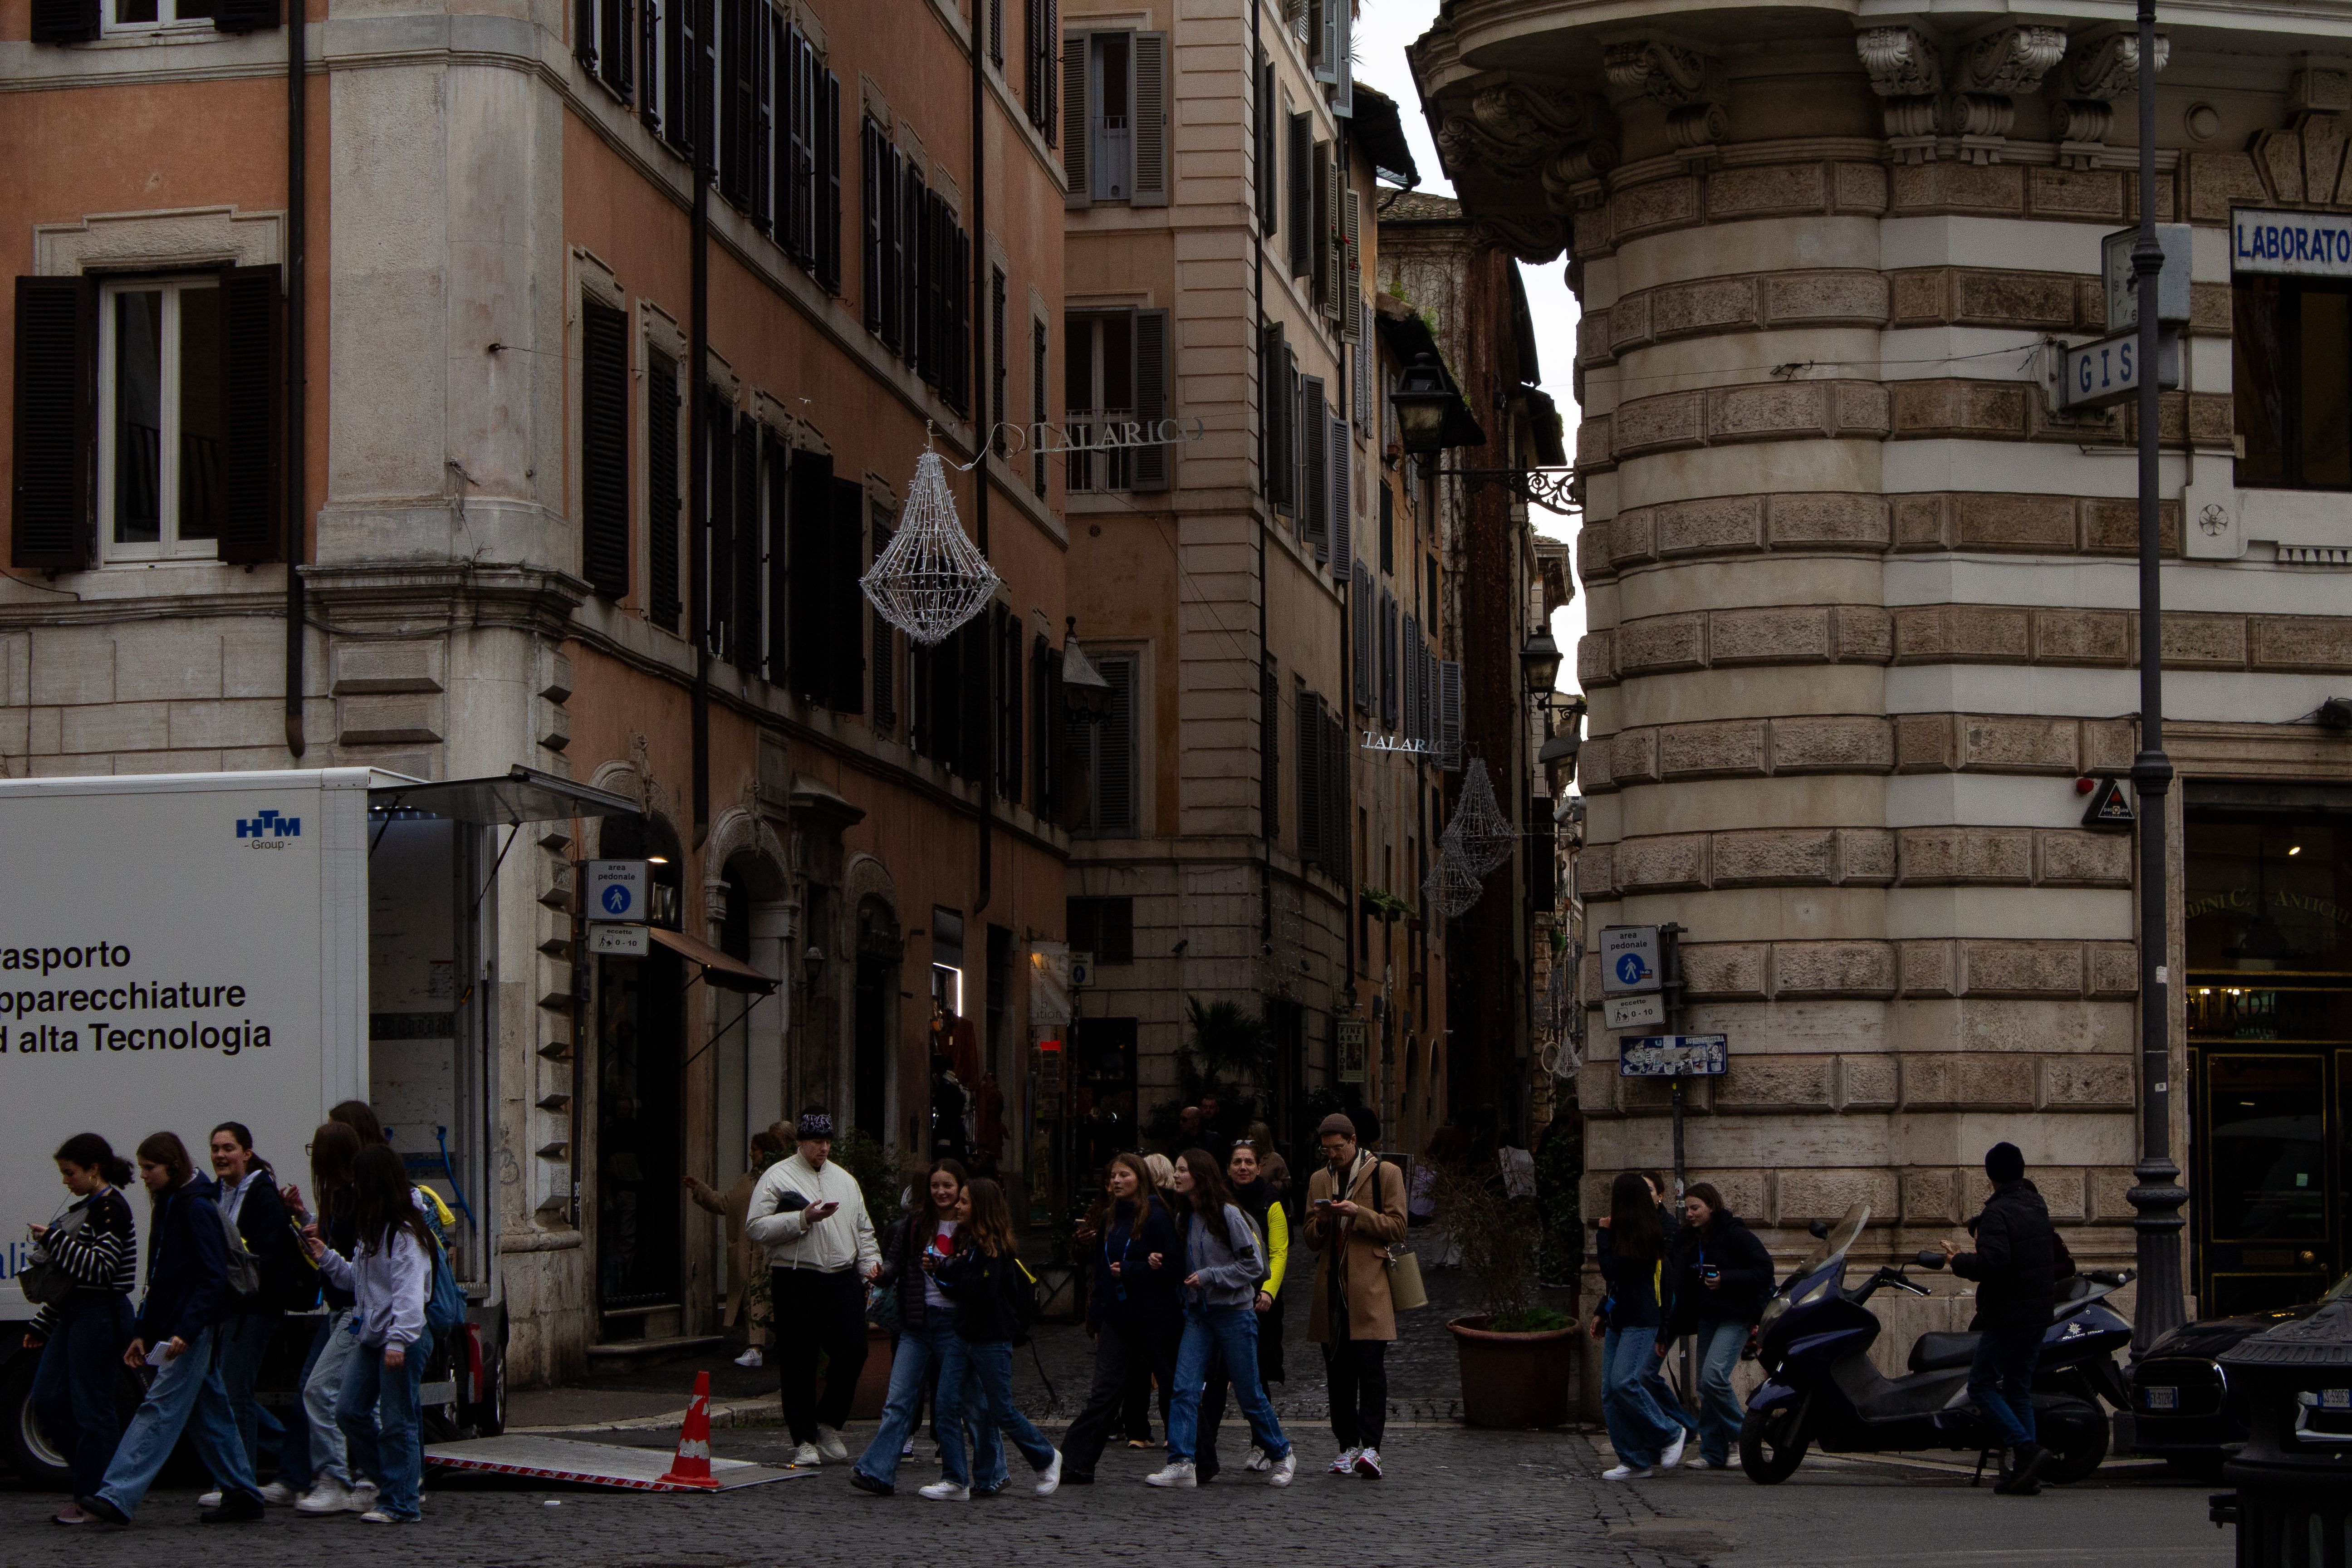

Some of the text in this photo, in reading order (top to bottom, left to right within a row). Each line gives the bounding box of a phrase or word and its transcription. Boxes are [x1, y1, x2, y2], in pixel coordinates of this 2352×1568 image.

[2237, 225, 2352, 262] LABORATO
[1362, 730, 1447, 753] TALARIC
[236, 810, 300, 838] HTM
[252, 840, 284, 851] Group
[2274, 889, 2352, 929] ANTICHI
[0, 941, 131, 976] asporto
[1611, 940, 1647, 951] pedonale
[19, 1025, 78, 1053] alta
[88, 1019, 271, 1056] Tecnologia
